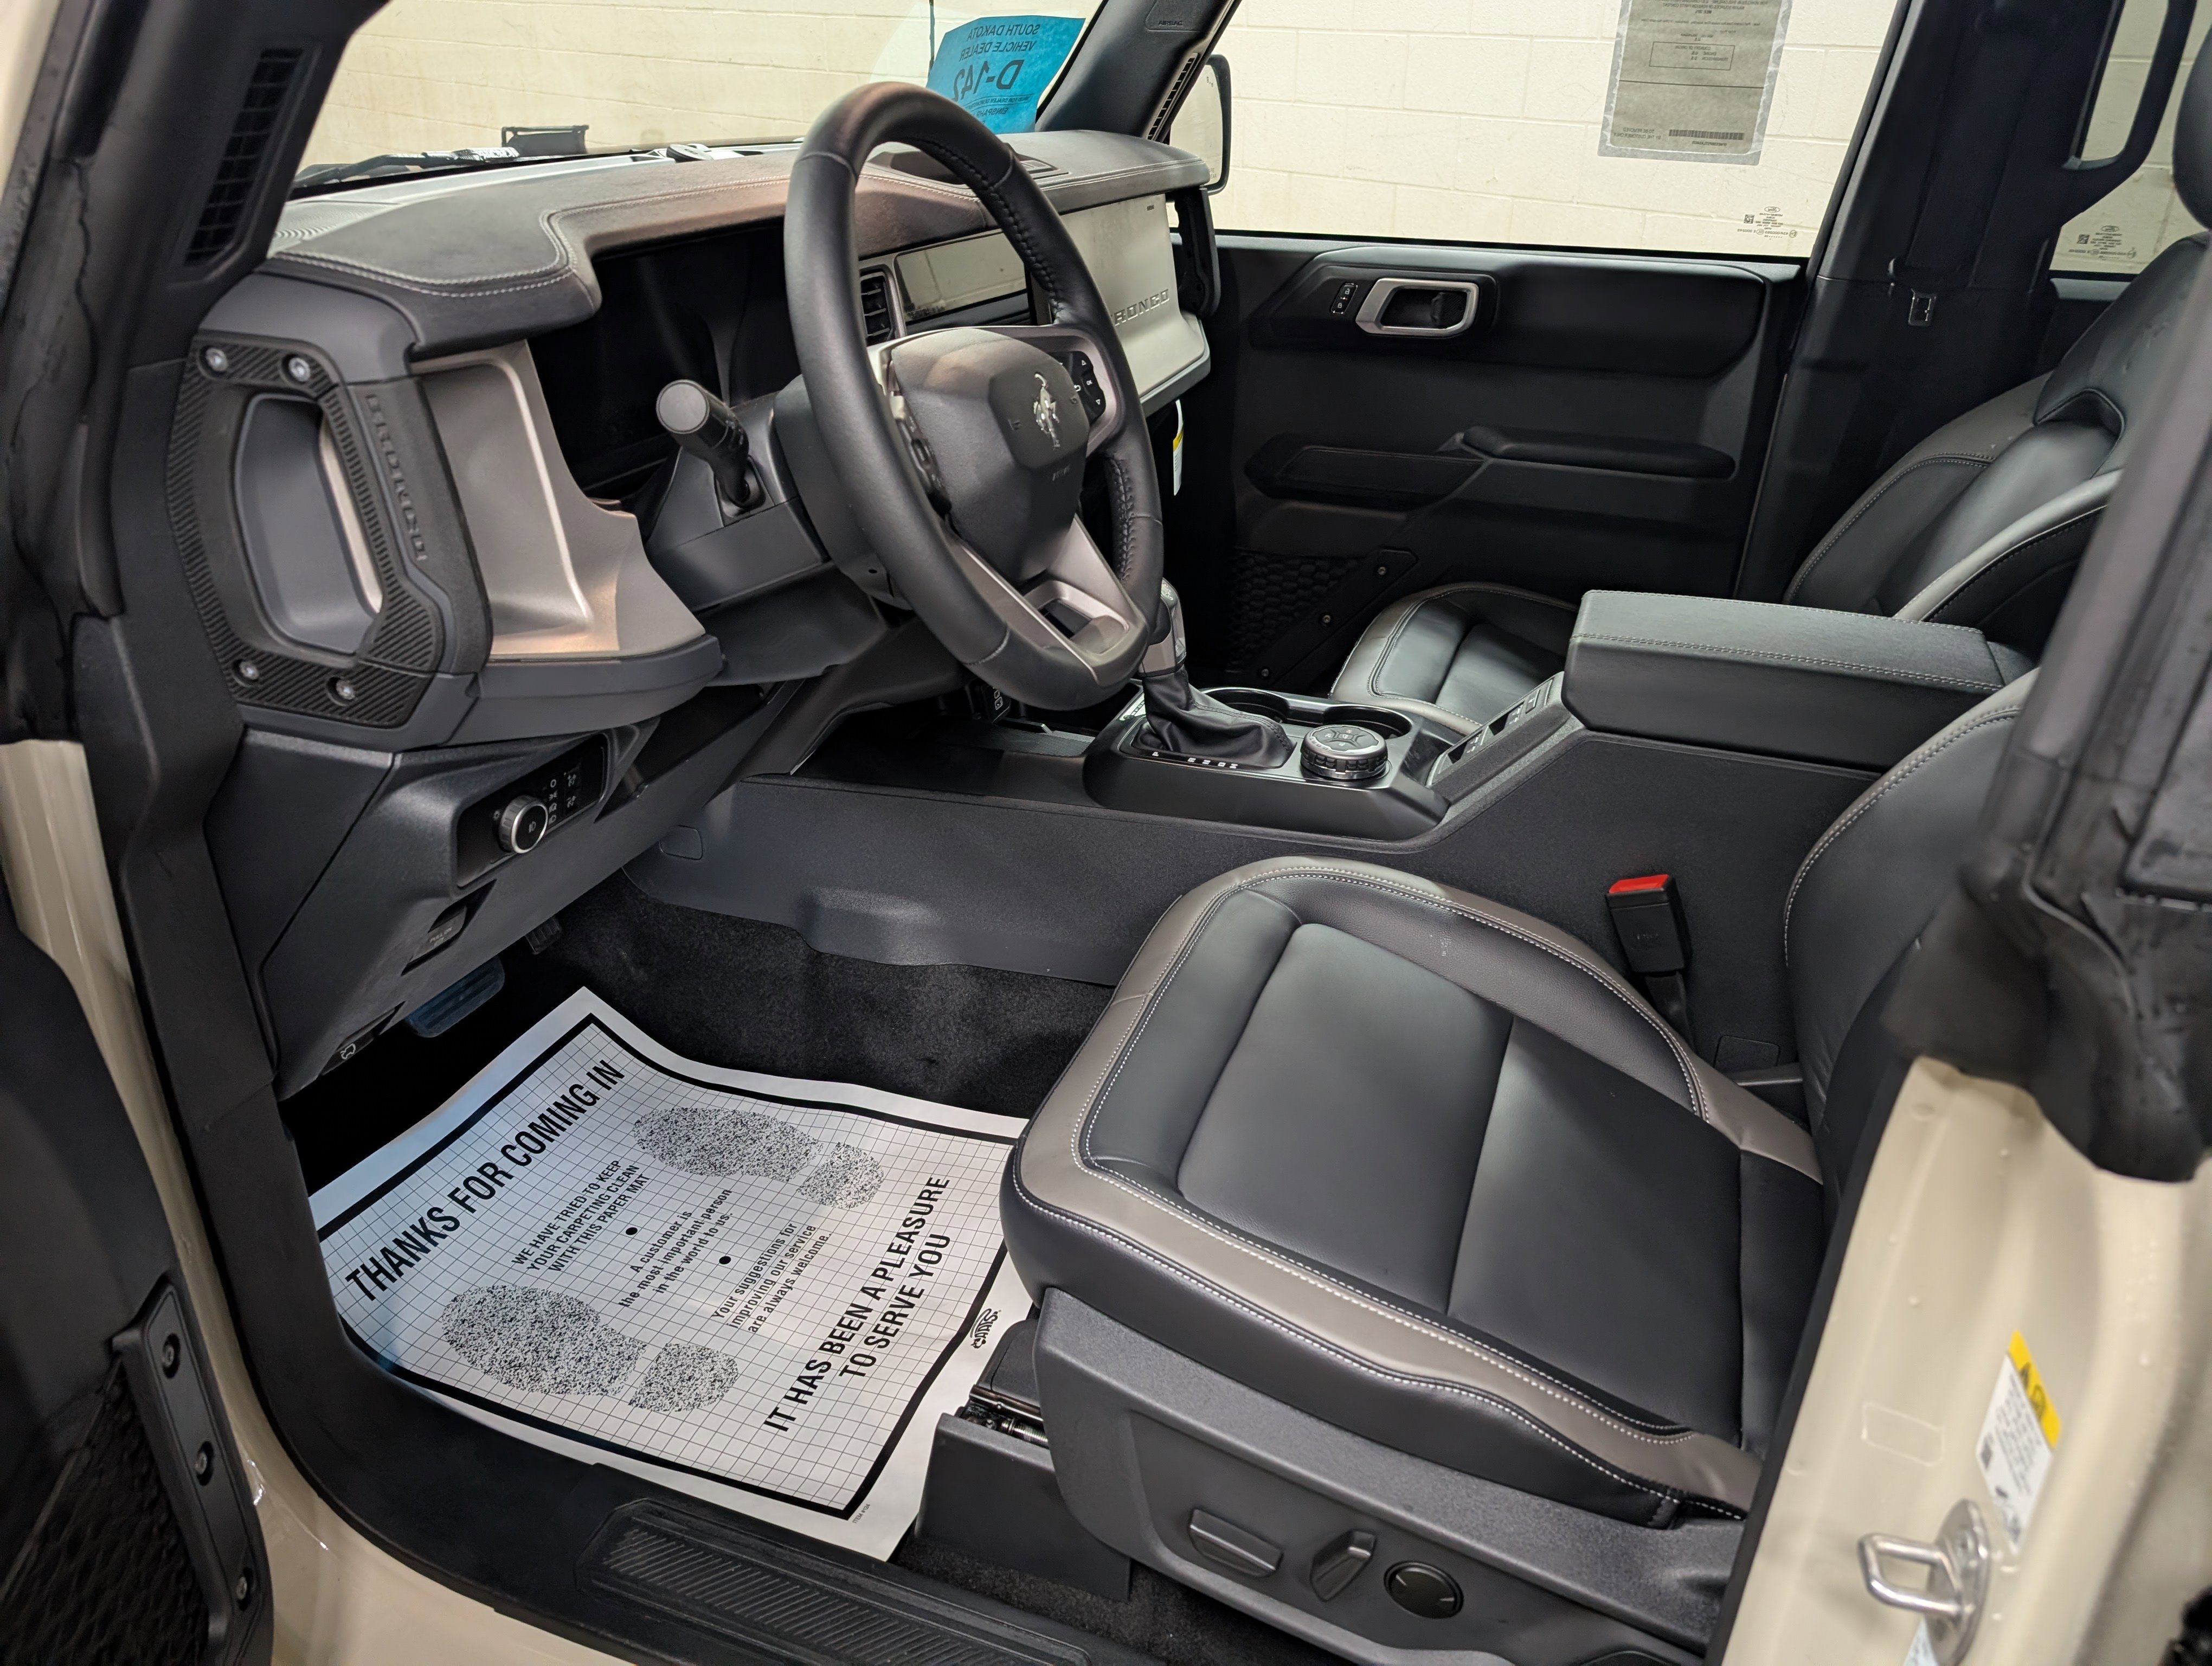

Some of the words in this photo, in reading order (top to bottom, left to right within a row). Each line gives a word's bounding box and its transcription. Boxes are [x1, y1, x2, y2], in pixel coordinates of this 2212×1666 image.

[1111, 289, 1170, 326] RONCO
[366, 394, 427, 561] BRONCO
[345, 1207, 460, 1301] THANKS
[447, 1162, 514, 1214] FOR
[501, 1084, 600, 1166] COMING
[586, 1060, 625, 1091] IN
[511, 1248, 535, 1265] WE
[529, 1223, 560, 1248] HAVE
[554, 1195, 587, 1221] TRIED
[582, 1182, 601, 1194] TO
[595, 1160, 621, 1182] KEEP
[526, 1244, 561, 1270] YOUR
[556, 1193, 612, 1244] CARPETING
[607, 1165, 640, 1193] CLEAN
[548, 1246, 580, 1272] WITH
[574, 1224, 602, 1244] THIS
[597, 1194, 632, 1223] PAPER
[626, 1174, 650, 1194] MAT
[871, 1177, 950, 1281] PLEASURE
[619, 1292, 640, 1307] the
[637, 1265, 664, 1290] most
[658, 1220, 704, 1264] important
[701, 1189, 732, 1220] person
[640, 1221, 682, 1263] customer
[677, 1211, 692, 1220] is
[652, 1283, 670, 1293] in
[664, 1266, 684, 1281] the
[680, 1238, 709, 1264] world
[704, 1227, 718, 1237] to
[716, 1213, 732, 1226] us.
[711, 1296, 738, 1318] Your
[735, 1238, 786, 1295] suggestions
[780, 1223, 797, 1236] for
[726, 1279, 776, 1328] improving
[770, 1259, 788, 1276] our
[785, 1226, 816, 1258] service
[748, 1315, 767, 1332] are
[763, 1278, 795, 1313] always
[791, 1233, 832, 1276] welcome.
[819, 1303, 873, 1354] BEEN
[838, 1355, 877, 1377] TO
[864, 1285, 925, 1349] SERVE
[909, 1234, 950, 1278] YOU
[860, 1285, 886, 1301] A
[763, 1407, 797, 1432] IT
[784, 1359, 832, 1405] HAS
